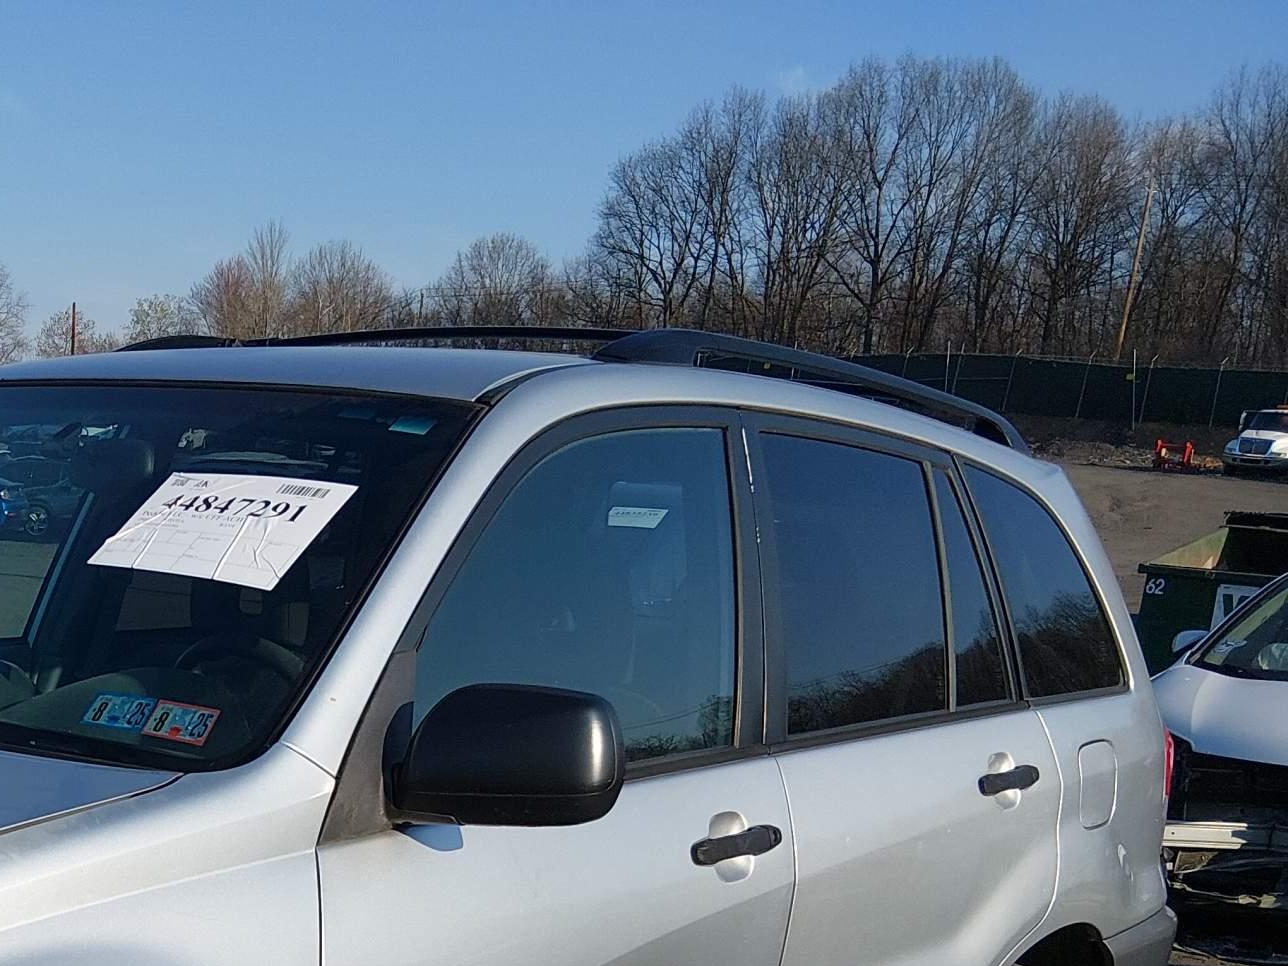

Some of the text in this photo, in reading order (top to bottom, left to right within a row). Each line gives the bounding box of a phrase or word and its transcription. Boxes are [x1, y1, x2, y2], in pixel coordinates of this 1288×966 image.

[162, 494, 307, 523] 44847291
[1145, 578, 1166, 595] 62
[125, 701, 152, 727] 25
[152, 711, 214, 738] 8 25
